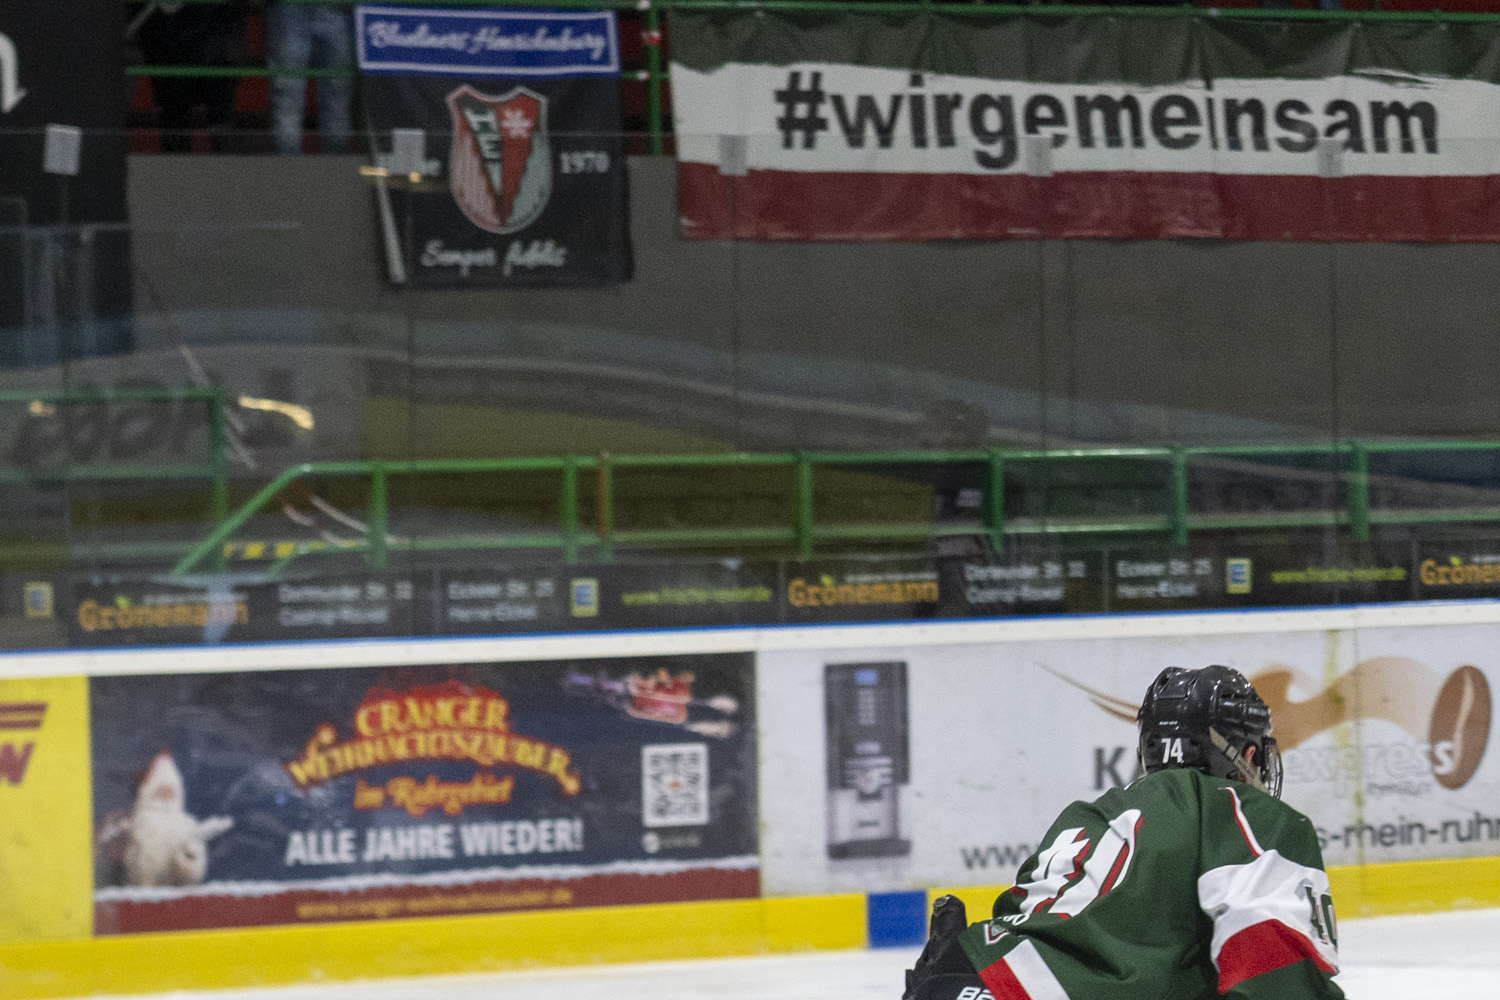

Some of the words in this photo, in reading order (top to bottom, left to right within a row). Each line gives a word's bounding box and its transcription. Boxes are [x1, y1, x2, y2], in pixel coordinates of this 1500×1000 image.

[775, 70, 1439, 170] #wirgemeinsam
[1161, 737, 1184, 764] 74
[285, 829, 355, 866] ALLE
[363, 824, 455, 862] JAHRE
[460, 818, 584, 857] WIEDER!
